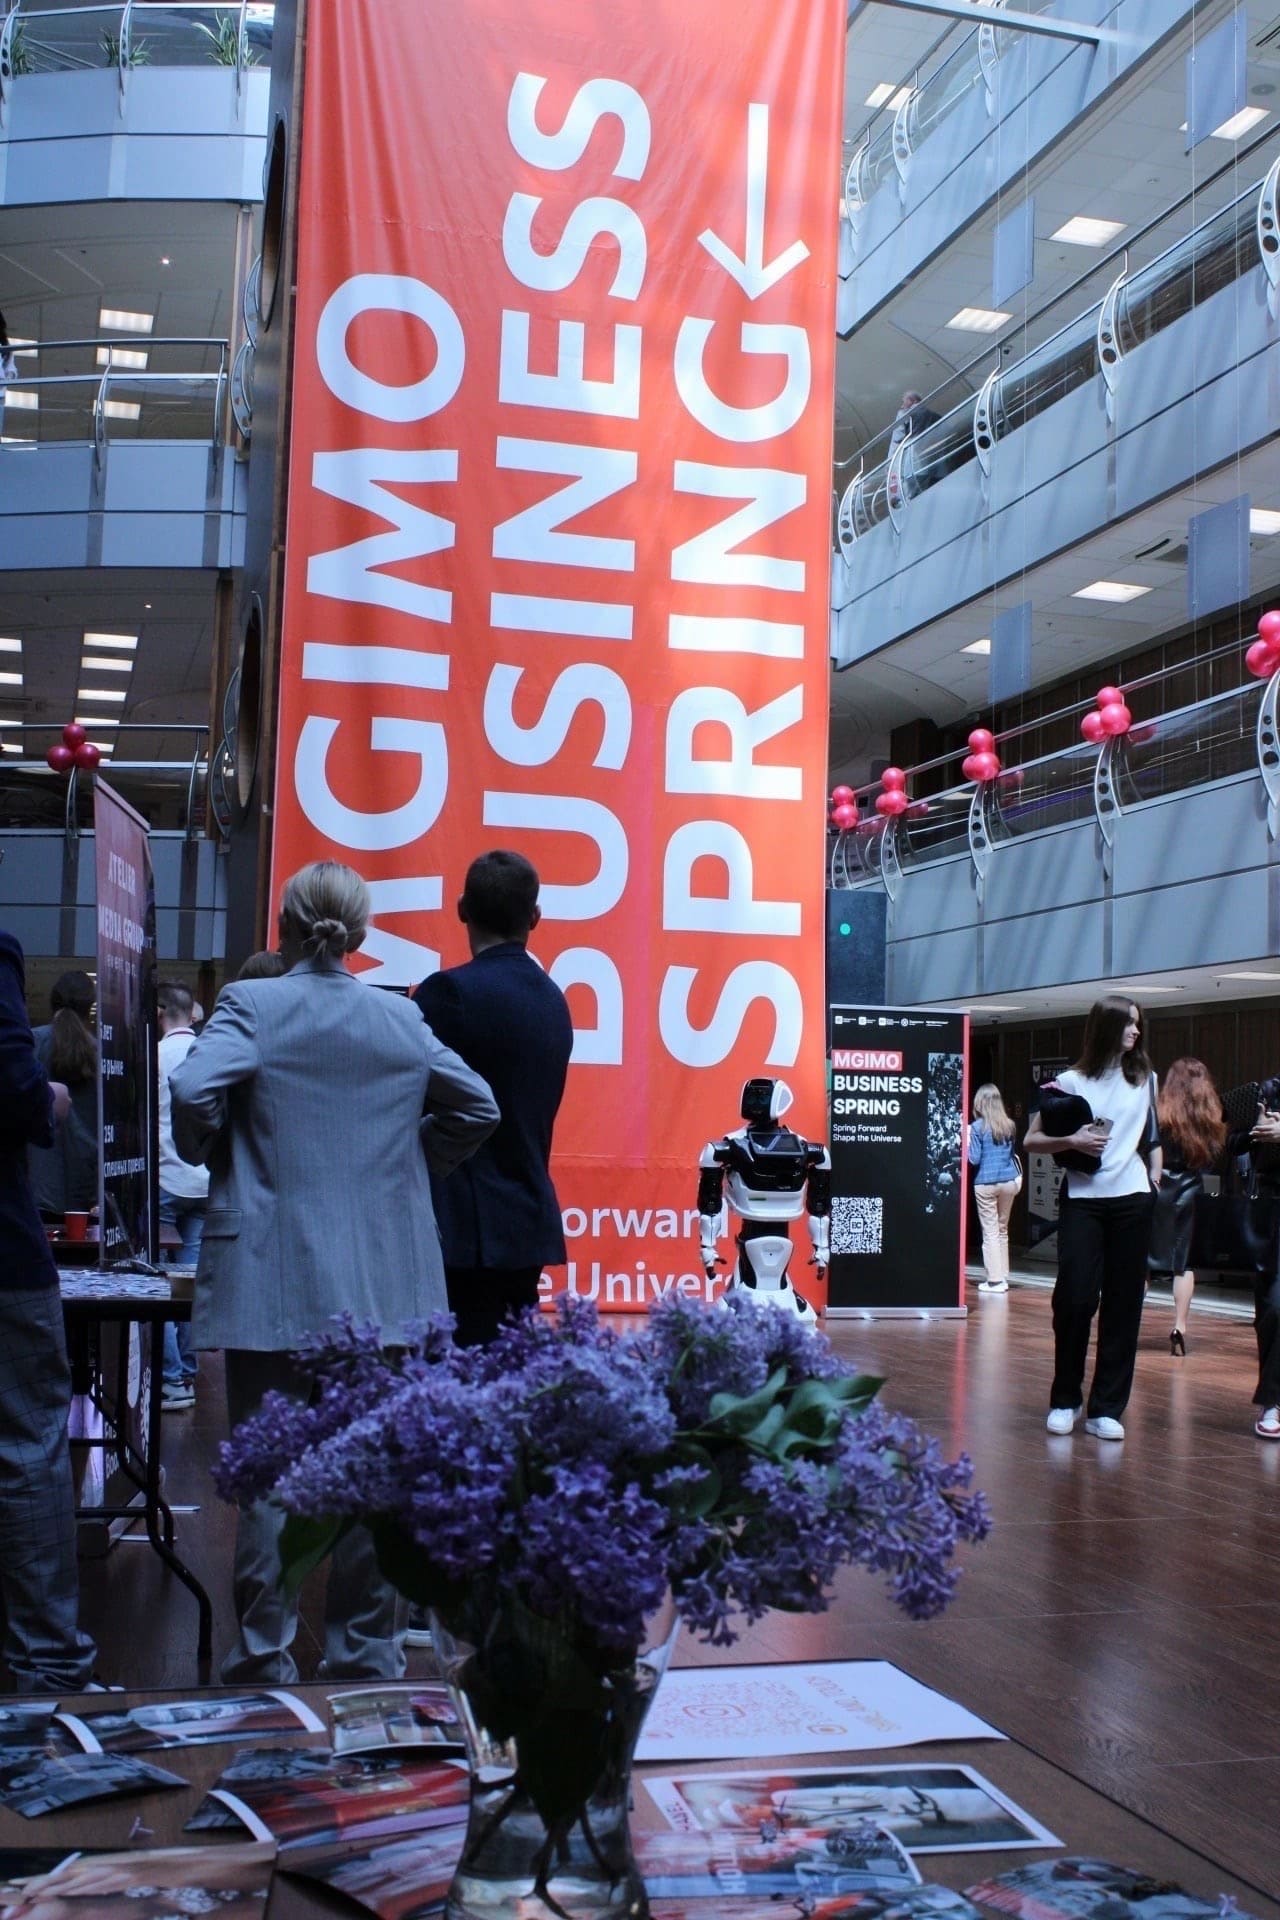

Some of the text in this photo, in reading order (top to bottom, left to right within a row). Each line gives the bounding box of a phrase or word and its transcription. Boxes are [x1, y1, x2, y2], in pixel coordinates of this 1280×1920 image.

[658, 316, 812, 1069] SPRING
[834, 1052, 900, 1069] MGIMO
[834, 1075, 923, 1093] BUSINESS
[833, 1098, 901, 1116] SPRING
[833, 1124, 888, 1133] Spring Forward
[833, 1134, 902, 1143] Shape the Universe
